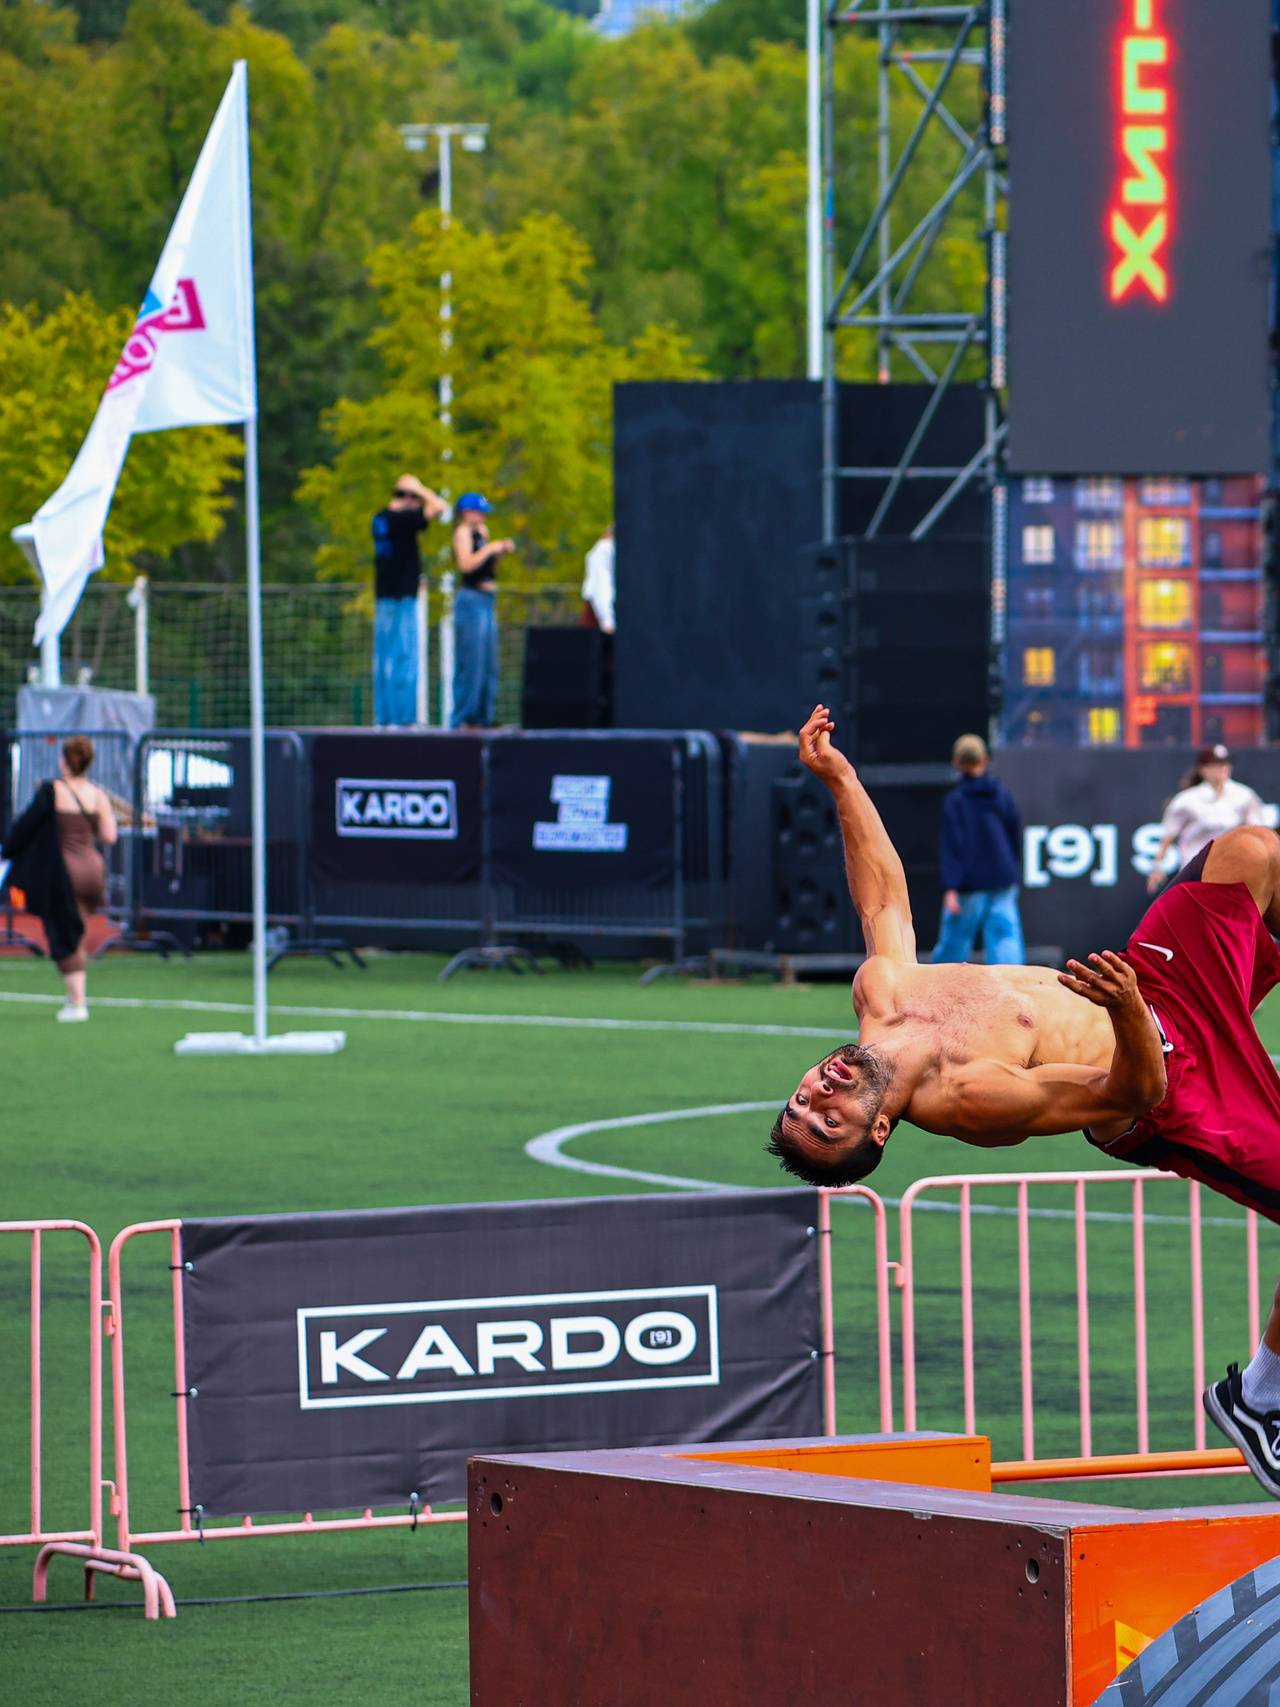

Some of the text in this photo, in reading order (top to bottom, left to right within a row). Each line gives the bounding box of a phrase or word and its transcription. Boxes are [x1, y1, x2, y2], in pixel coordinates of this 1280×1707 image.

[342, 790, 450, 826] KARDO
[1022, 823, 1118, 887] [9]
[319, 1310, 698, 1384] KARDO
